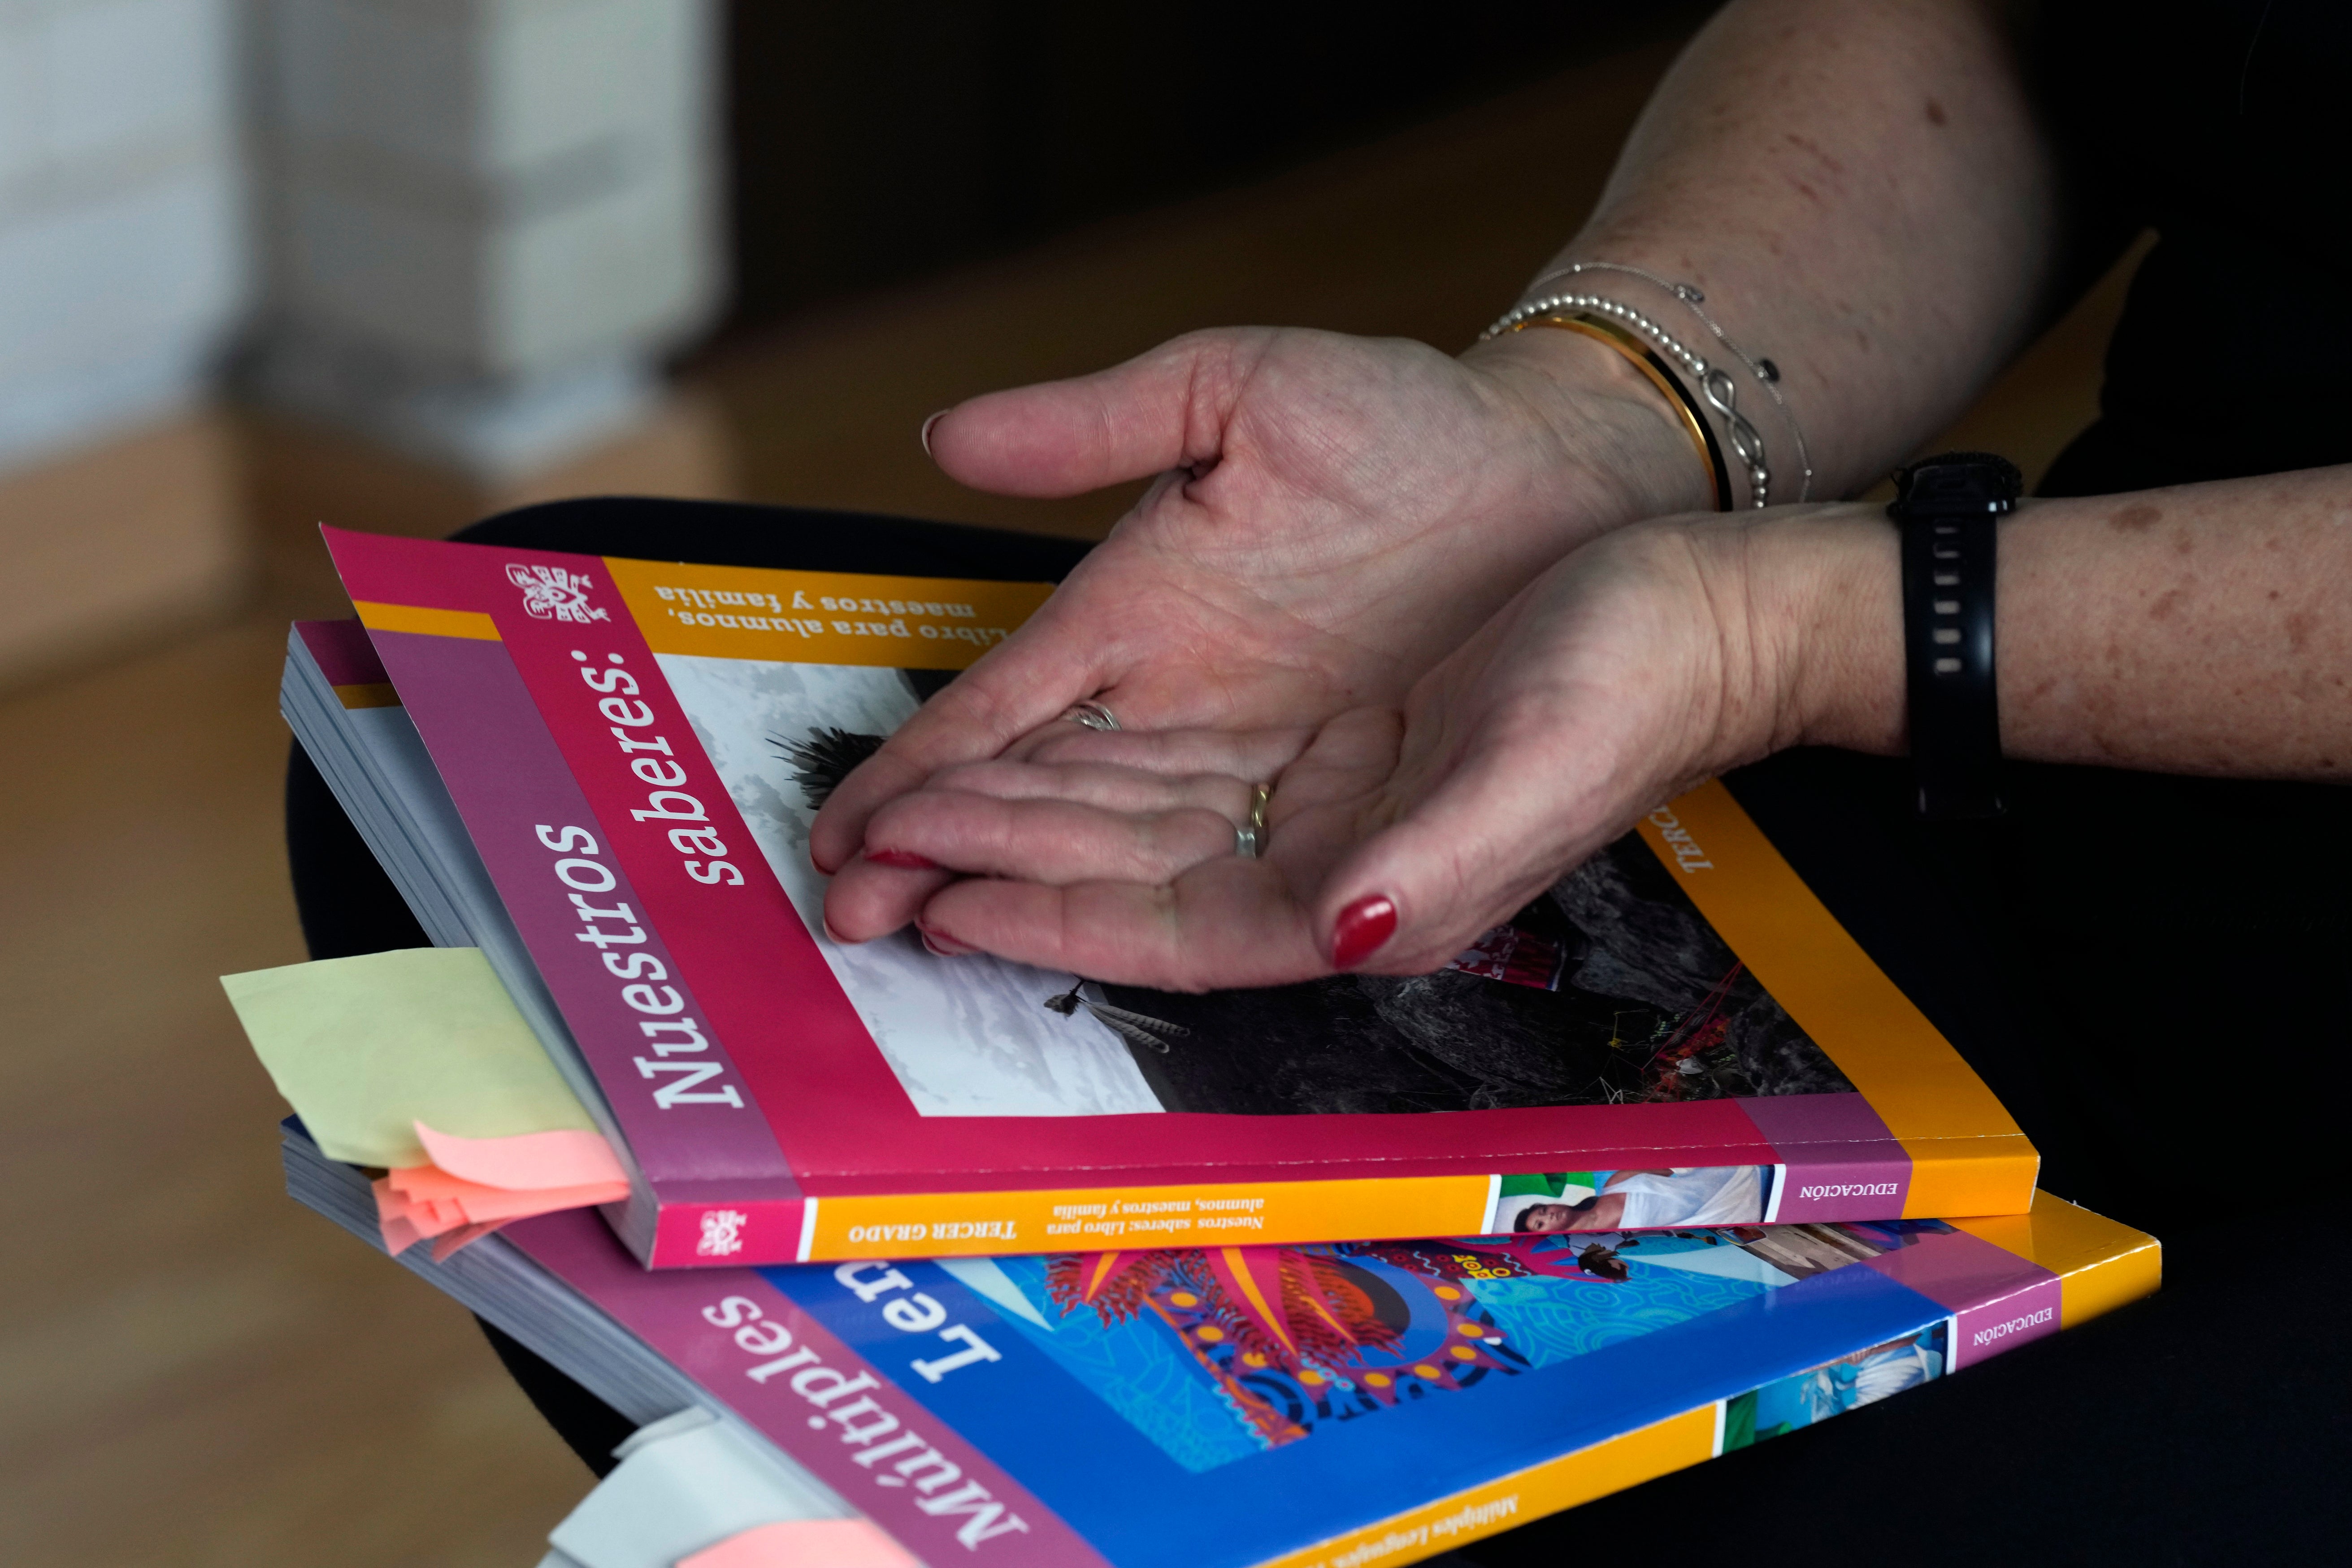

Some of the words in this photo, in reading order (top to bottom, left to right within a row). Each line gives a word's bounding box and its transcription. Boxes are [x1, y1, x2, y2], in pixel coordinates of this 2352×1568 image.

[654, 586, 782, 613] familia
[792, 590, 814, 610] y
[820, 597, 976, 618] maestros
[668, 608, 824, 638] alumnos,
[831, 619, 910, 638] para
[571, 650, 745, 886] saberes:
[535, 824, 745, 1109] Nuestros
[1799, 1183, 1898, 1201] EDUCACIÓN
[1053, 1204, 1107, 1220] familia
[1110, 1200, 1120, 1214] y
[1122, 1201, 1191, 1215] maestros
[1195, 1198, 1264, 1213] alumnos,
[932, 1221, 1017, 1240] TERCER
[1046, 1221, 1083, 1236] para
[1087, 1221, 1125, 1236] Libro
[1128, 1218, 1191, 1233] saberes:
[1198, 1216, 1264, 1229] Nuestros
[848, 1224, 927, 1243] GRADO
[1974, 1307, 2053, 1346] EDUCACIÓN
[701, 1295, 1030, 1551] Múltiples
